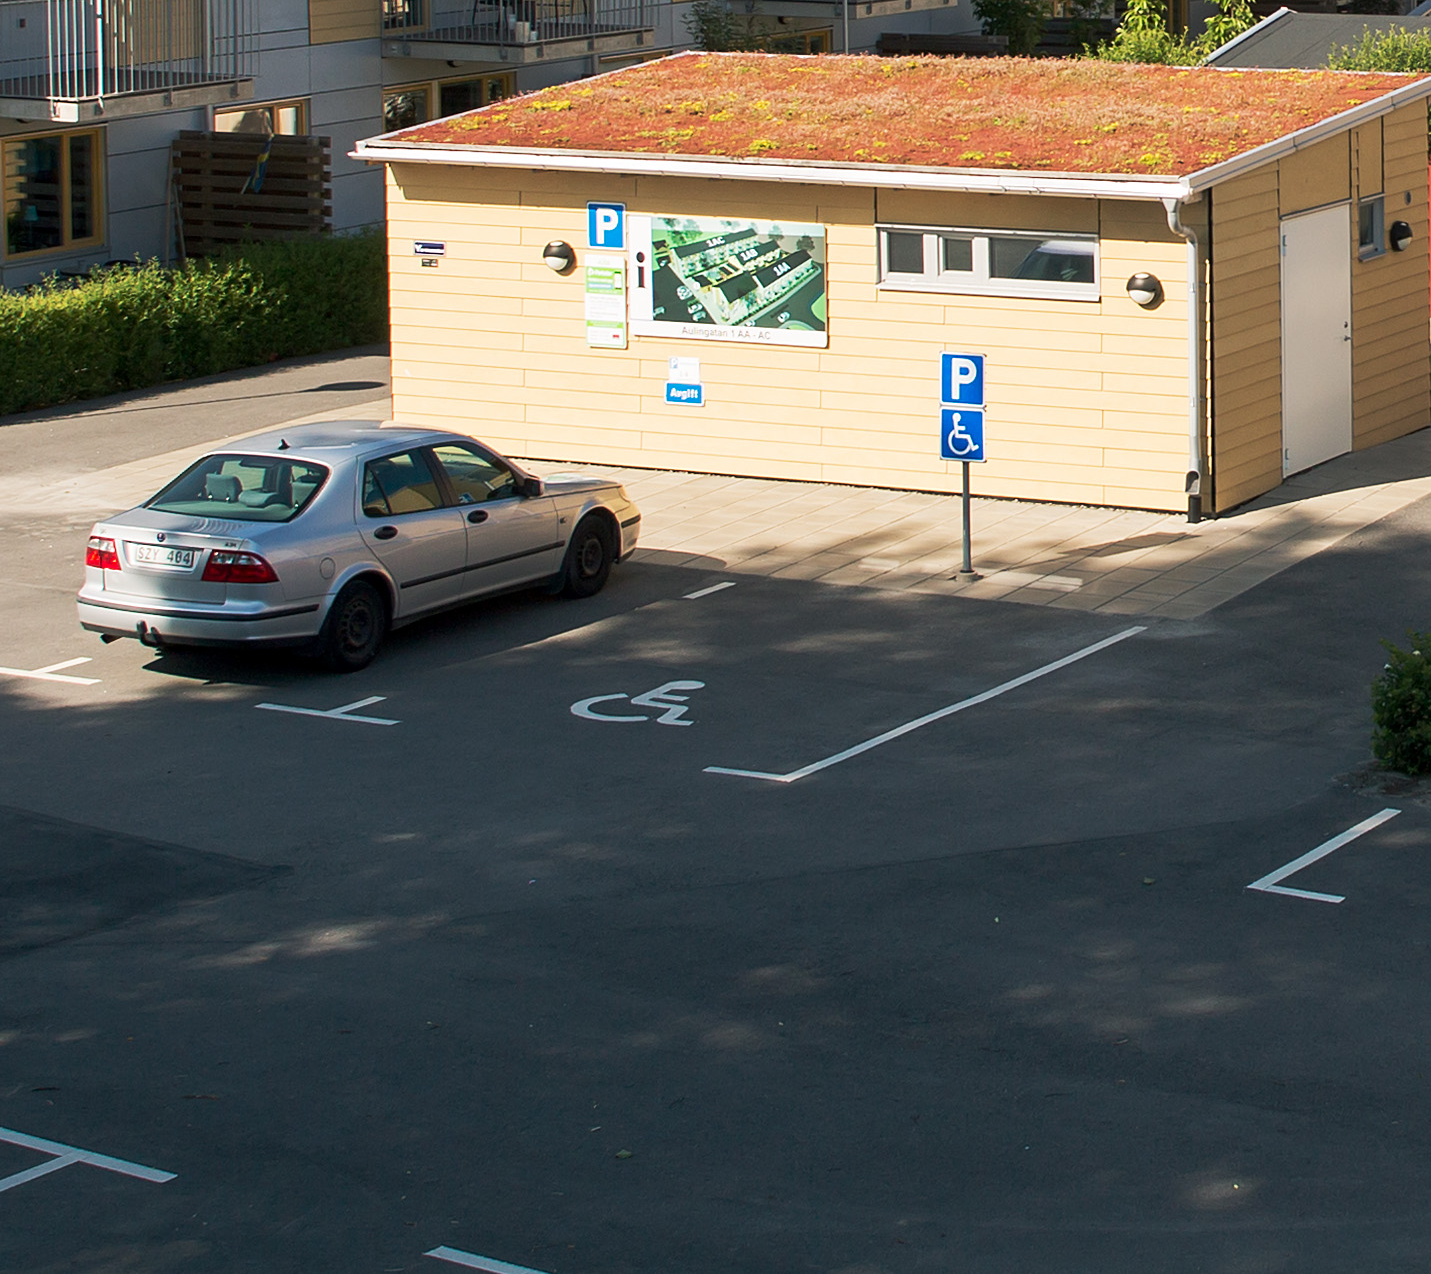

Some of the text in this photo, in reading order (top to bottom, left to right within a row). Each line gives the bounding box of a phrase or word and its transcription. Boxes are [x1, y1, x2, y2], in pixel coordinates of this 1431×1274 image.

[596, 208, 619, 245] P
[706, 236, 726, 247] 1AC
[682, 326, 728, 338] Aulingatan
[731, 329, 735, 337] 1
[738, 330, 750, 338] AA
[758, 331, 771, 339] AC
[951, 357, 977, 400] P
[670, 387, 699, 400] Avgift
[138, 546, 191, 565] SZY 404
